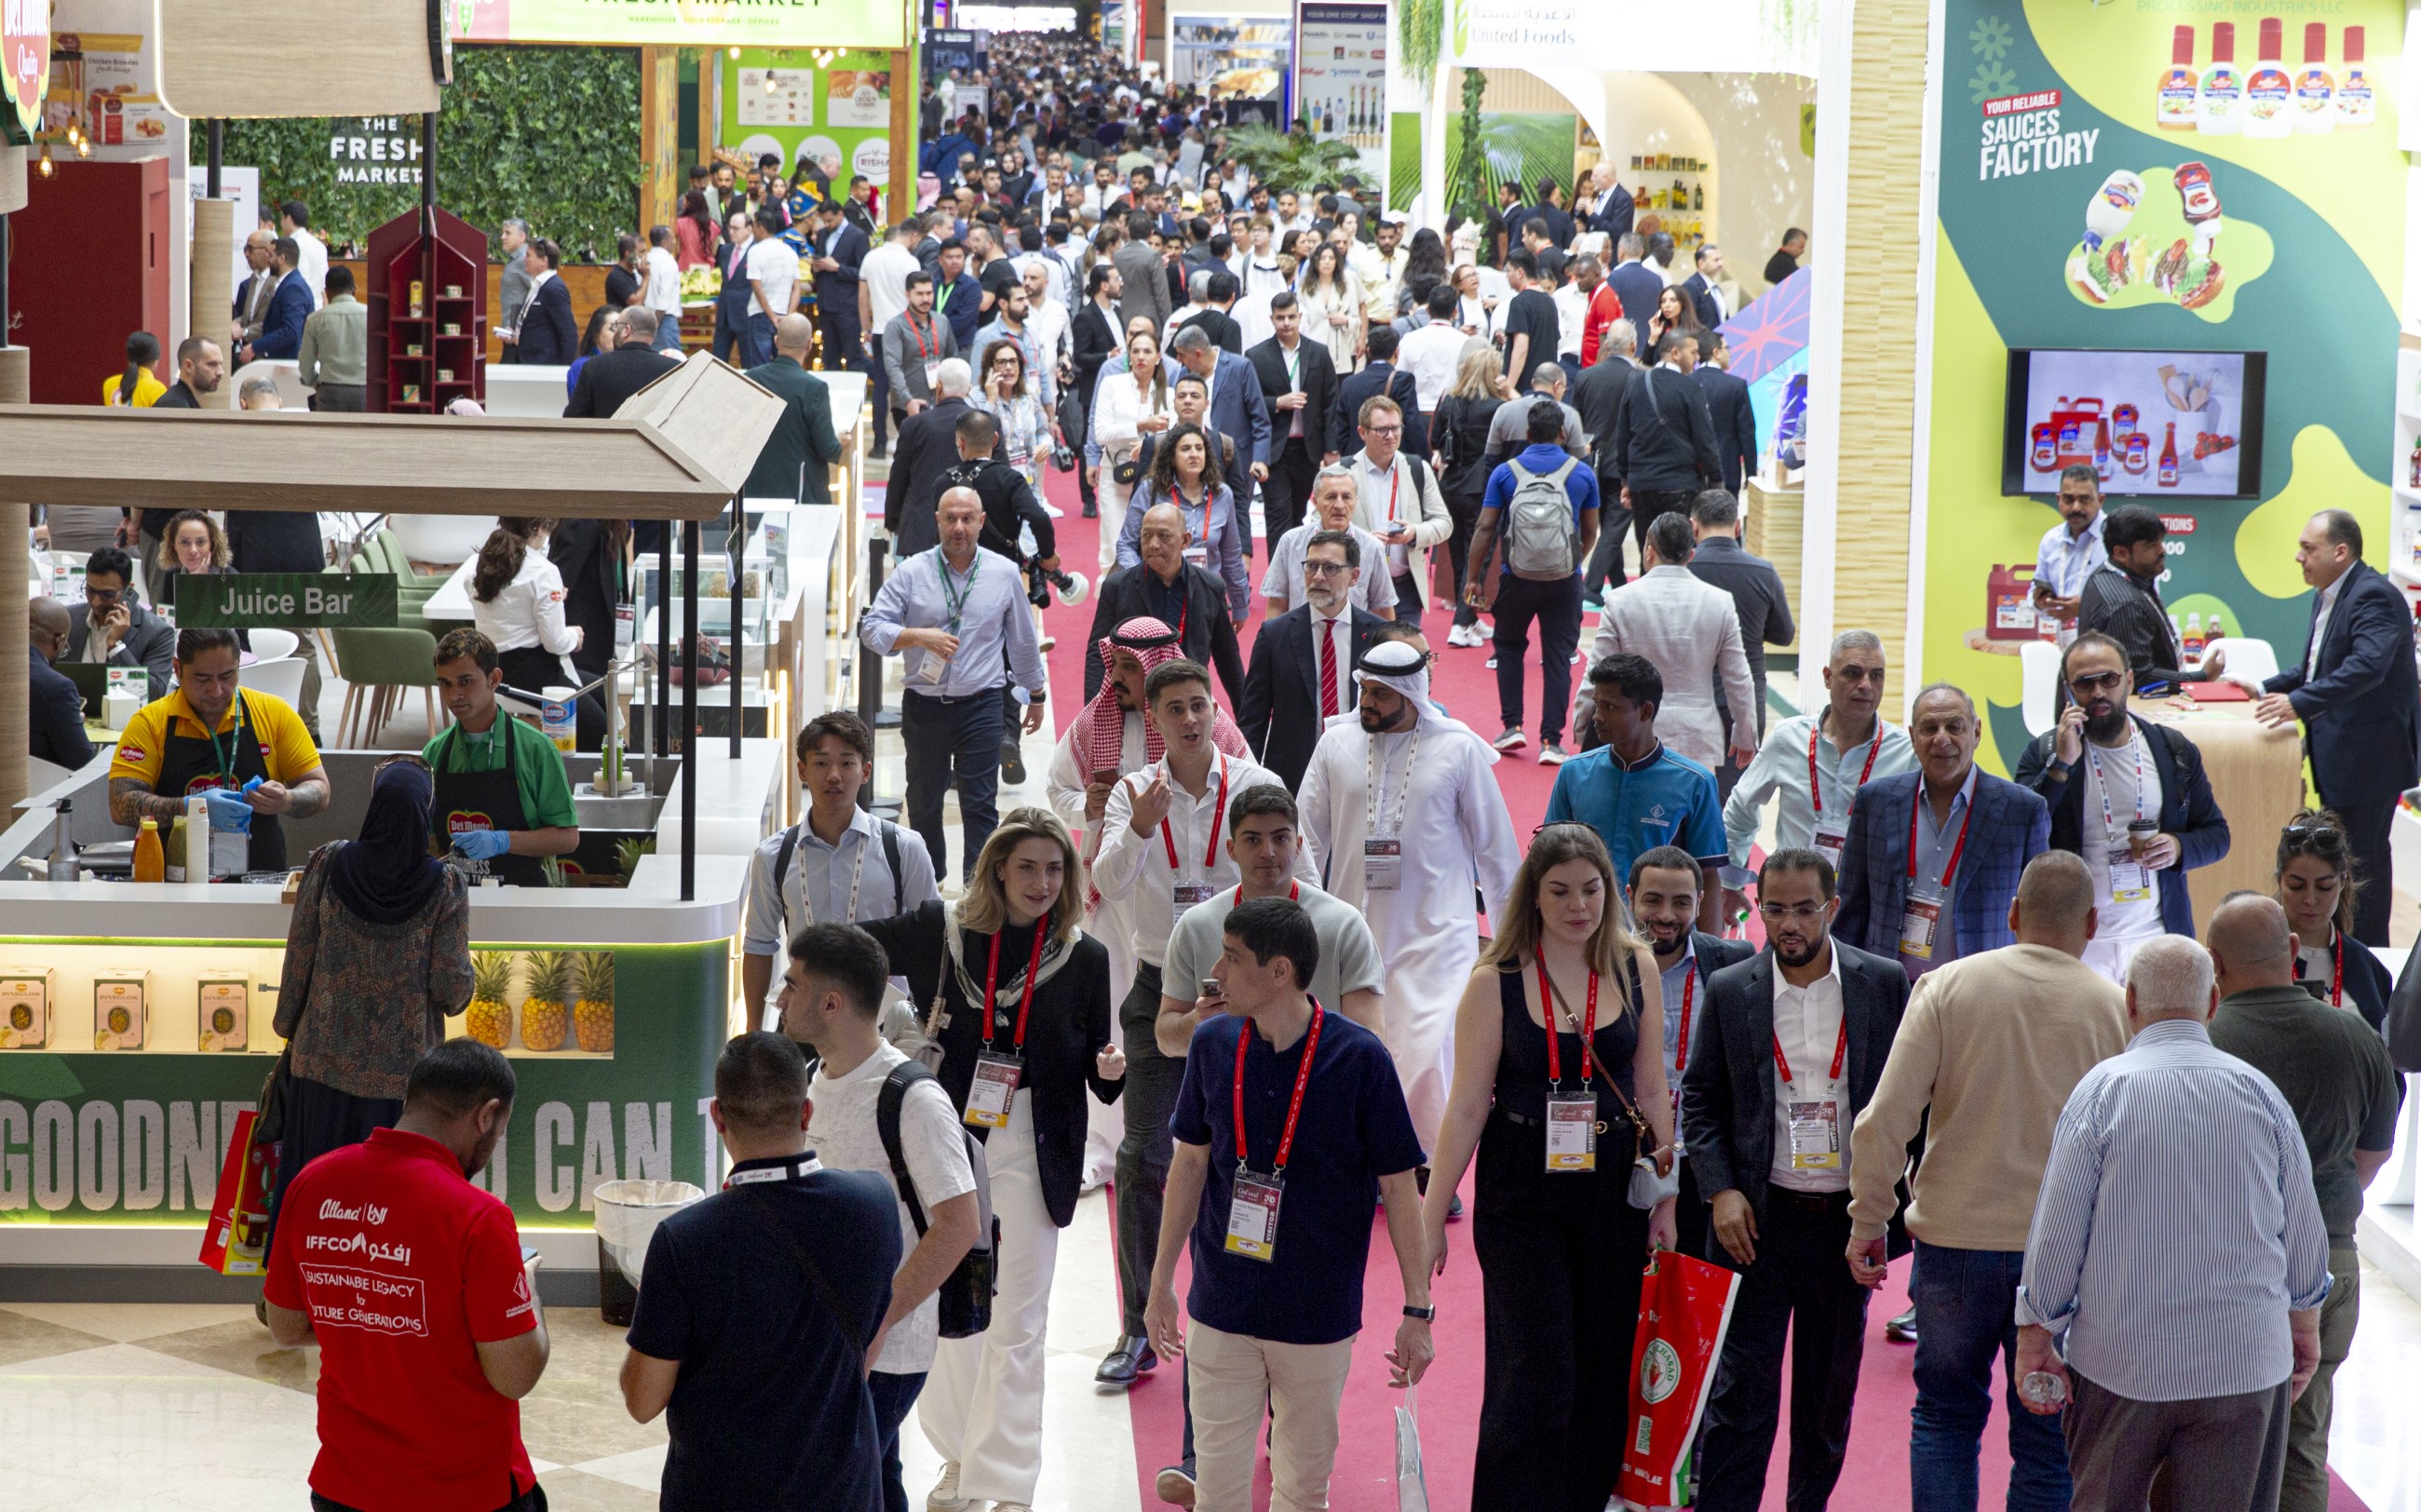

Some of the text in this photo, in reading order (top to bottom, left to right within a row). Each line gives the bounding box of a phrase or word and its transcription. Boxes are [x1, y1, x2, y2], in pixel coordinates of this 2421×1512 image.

[2137, 0, 2344, 13] PROCESSING INDUSTRIES LLC
[1472, 27, 1576, 44] United Foods
[1986, 92, 2057, 115] YOUR RELIABLE
[362, 117, 398, 131] THE
[1981, 109, 2061, 146] SAUCES
[331, 136, 423, 161] FRESH
[1980, 128, 2100, 181] FACTORY
[338, 166, 424, 183] MARKET
[220, 587, 353, 614] Juice Bar
[128, 670, 146, 679] MENU
[451, 820, 491, 831] Del Monte
[1004, 1087, 1015, 1113] VISITOR
[534, 1100, 672, 1212] CAN
[1265, 1211, 1276, 1242] VISITOR
[305, 1235, 352, 1252] IFFCO
[306, 1270, 415, 1298] SUSTAINABLE LEGACY
[357, 1292, 366, 1306] for
[313, 1304, 422, 1331] UTURE GENERATIONS
